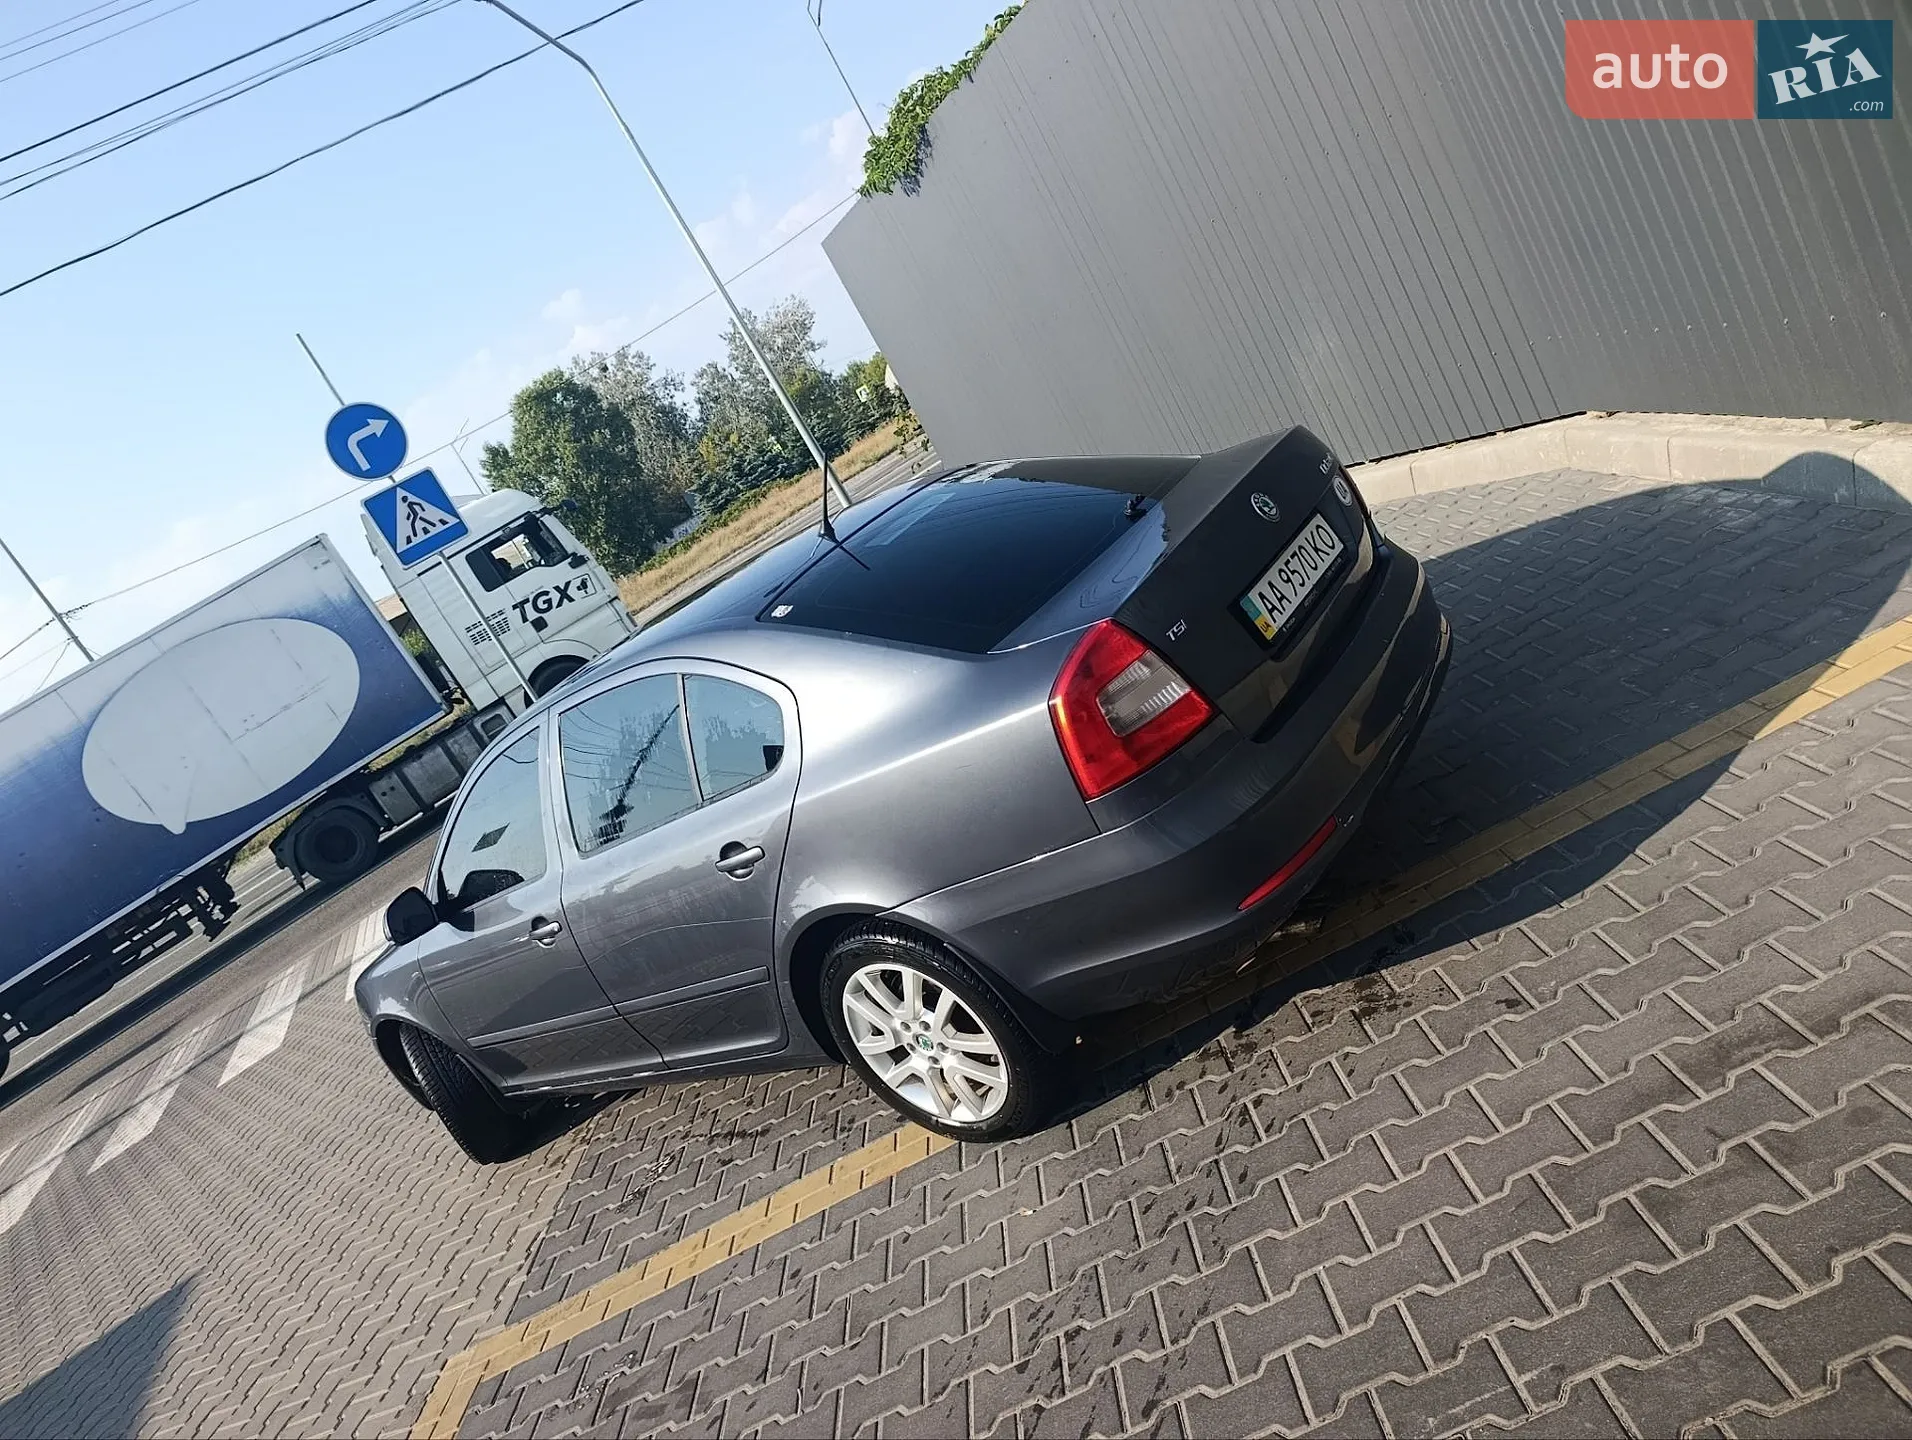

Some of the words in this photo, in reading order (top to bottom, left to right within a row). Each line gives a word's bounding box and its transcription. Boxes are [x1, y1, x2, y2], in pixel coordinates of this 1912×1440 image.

[1257, 580, 1292, 624] AA
[1278, 545, 1318, 597] 9570
[1304, 524, 1336, 563] KO
[511, 579, 576, 624] TGX
[1260, 620, 1272, 633] UA
